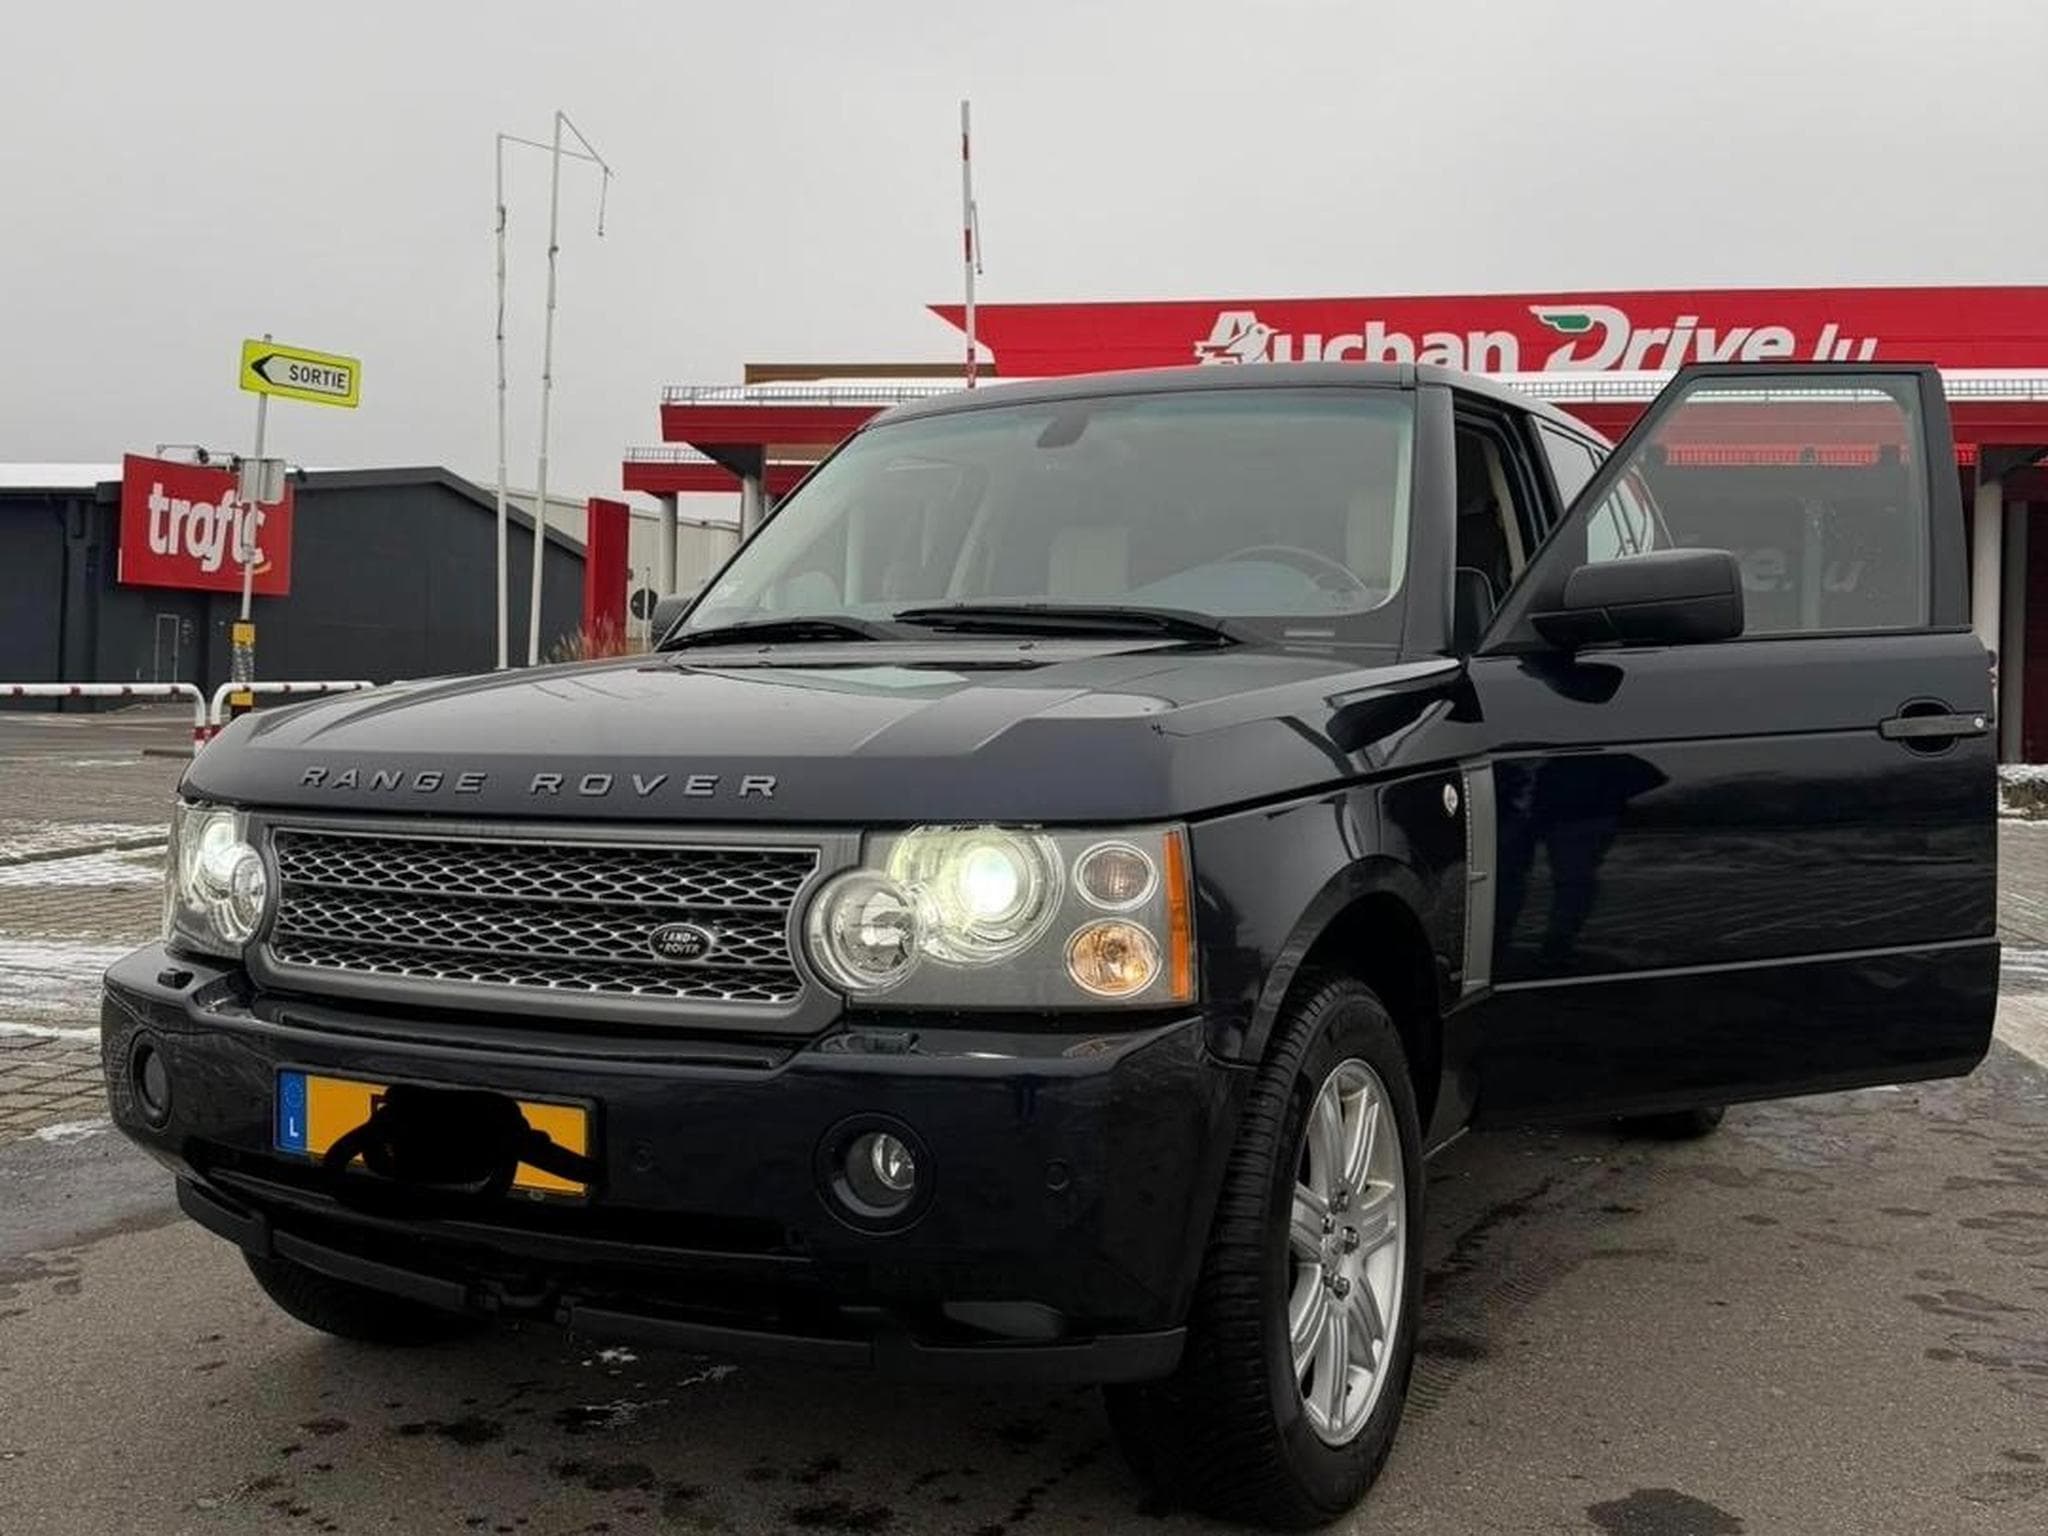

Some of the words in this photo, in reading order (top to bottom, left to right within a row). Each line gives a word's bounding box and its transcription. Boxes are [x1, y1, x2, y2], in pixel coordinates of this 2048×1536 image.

[1195, 311, 1519, 373] Auchan
[289, 364, 347, 389] SORTIE
[301, 766, 487, 793] RANGE
[529, 773, 777, 797] ROVER
[662, 931, 692, 942] LAND
[664, 943, 700, 954] ROVER
[289, 1116, 299, 1138] L
